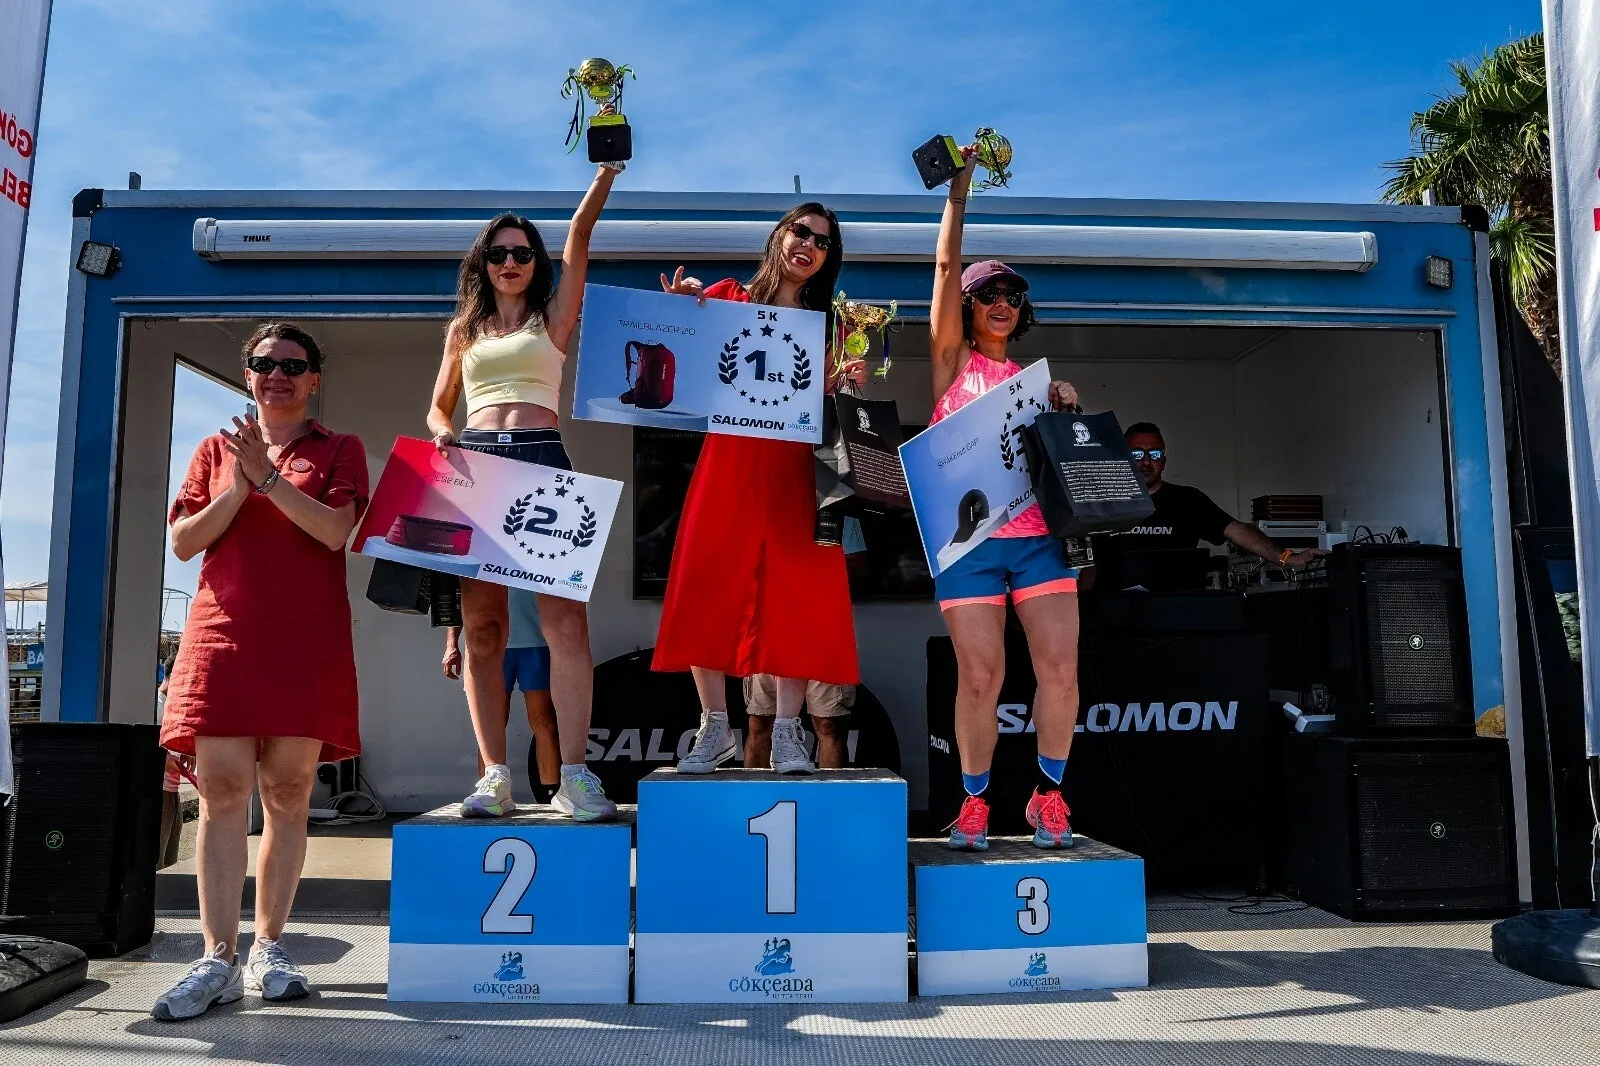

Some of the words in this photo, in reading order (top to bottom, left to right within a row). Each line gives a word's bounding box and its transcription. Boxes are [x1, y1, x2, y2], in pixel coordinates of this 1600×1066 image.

[243, 235, 271, 243] THULE
[618, 319, 680, 334] TRAILBLAZER
[681, 326, 696, 336] 20
[712, 414, 785, 431] SALOMON
[453, 478, 476, 489] BELT
[524, 505, 573, 540] 2nd
[482, 563, 556, 586] SALOMON
[996, 701, 1238, 733] SOMON
[747, 800, 798, 915] 1
[481, 837, 538, 934] 2
[1016, 877, 1051, 936] 3
